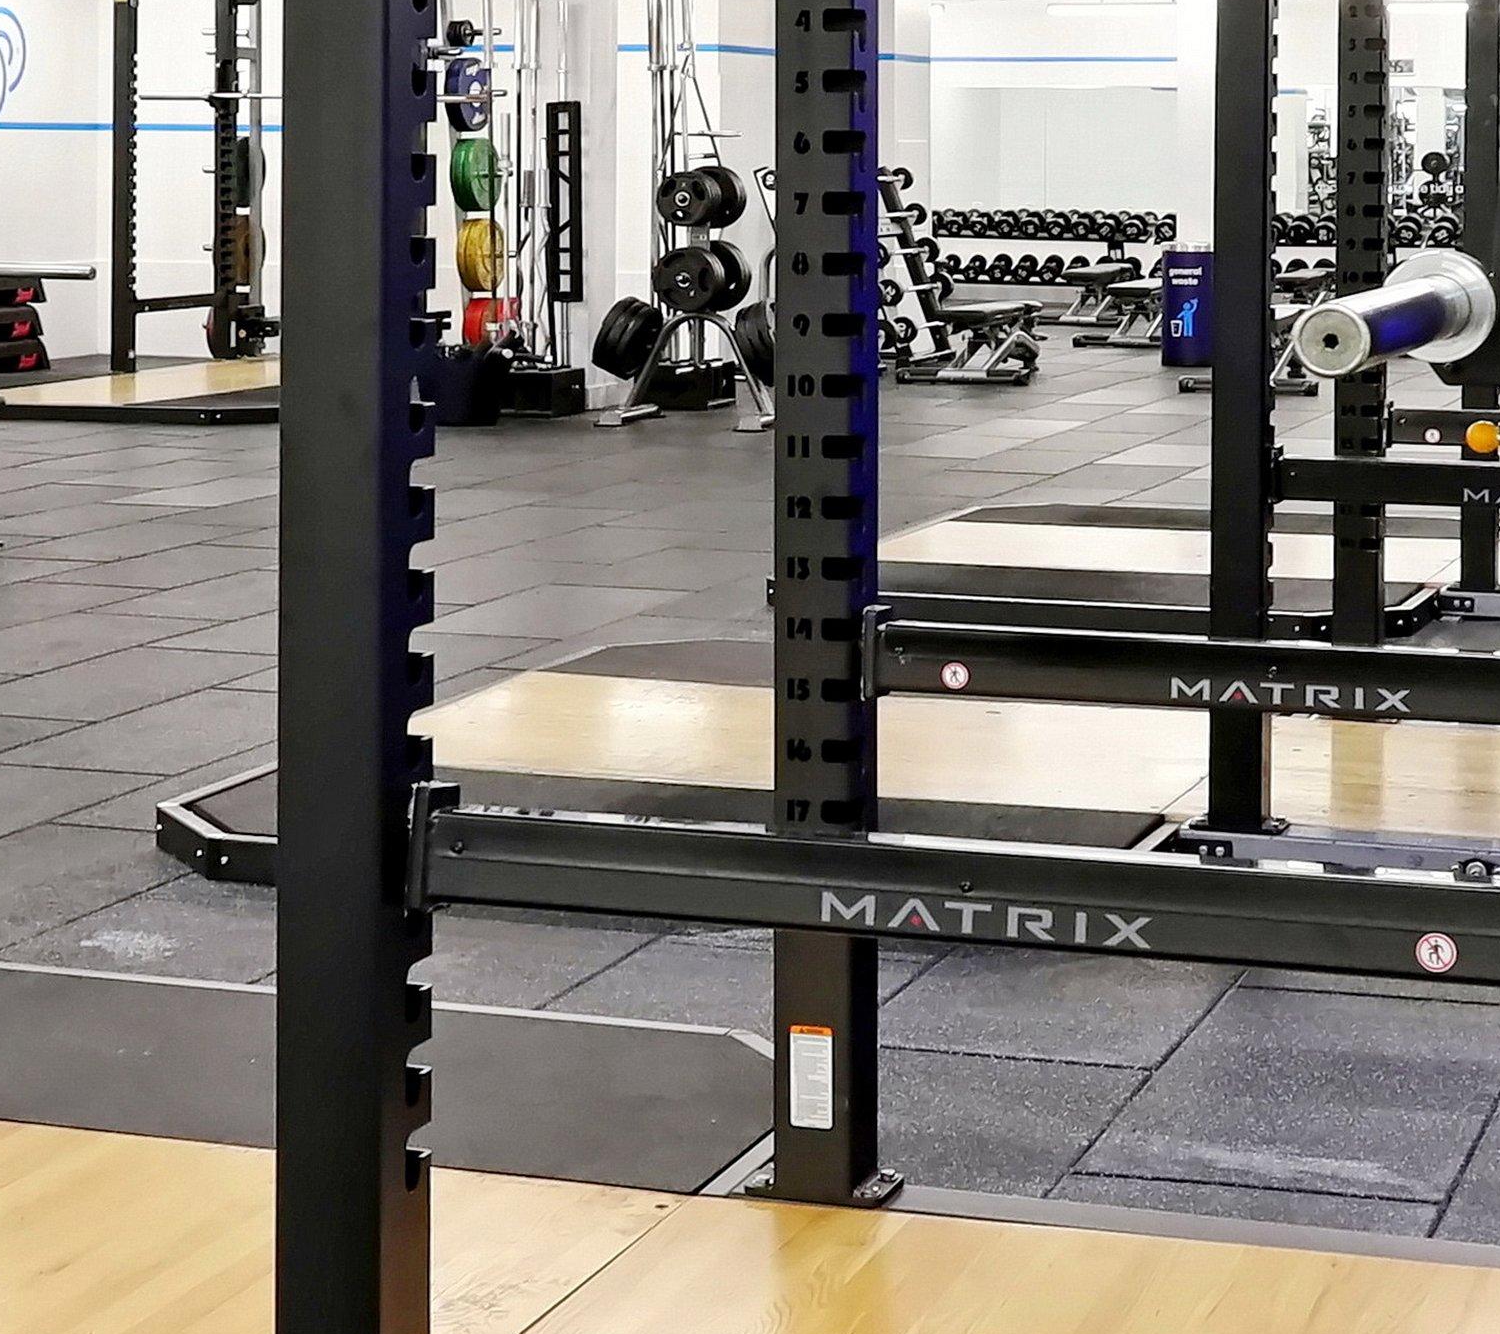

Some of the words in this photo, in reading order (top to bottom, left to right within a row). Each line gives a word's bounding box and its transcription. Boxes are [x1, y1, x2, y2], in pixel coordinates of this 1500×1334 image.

[795, 9, 811, 32] 4
[794, 70, 809, 94] 5
[793, 131, 811, 155] 6
[793, 192, 809, 215] 7
[791, 252, 809, 276] 8
[1168, 267, 1202, 277] general
[1171, 278, 1199, 286] waste
[792, 313, 810, 337] 9
[787, 374, 815, 397] 10
[787, 435, 810, 458] 11
[787, 496, 812, 519] 12
[787, 556, 810, 580] 13
[787, 617, 812, 641] 14
[787, 678, 810, 701] 15
[1170, 676, 1411, 713] MATRIX
[787, 738, 812, 762] 16
[787, 799, 810, 822] 17
[820, 891, 1153, 949] MATRIX
